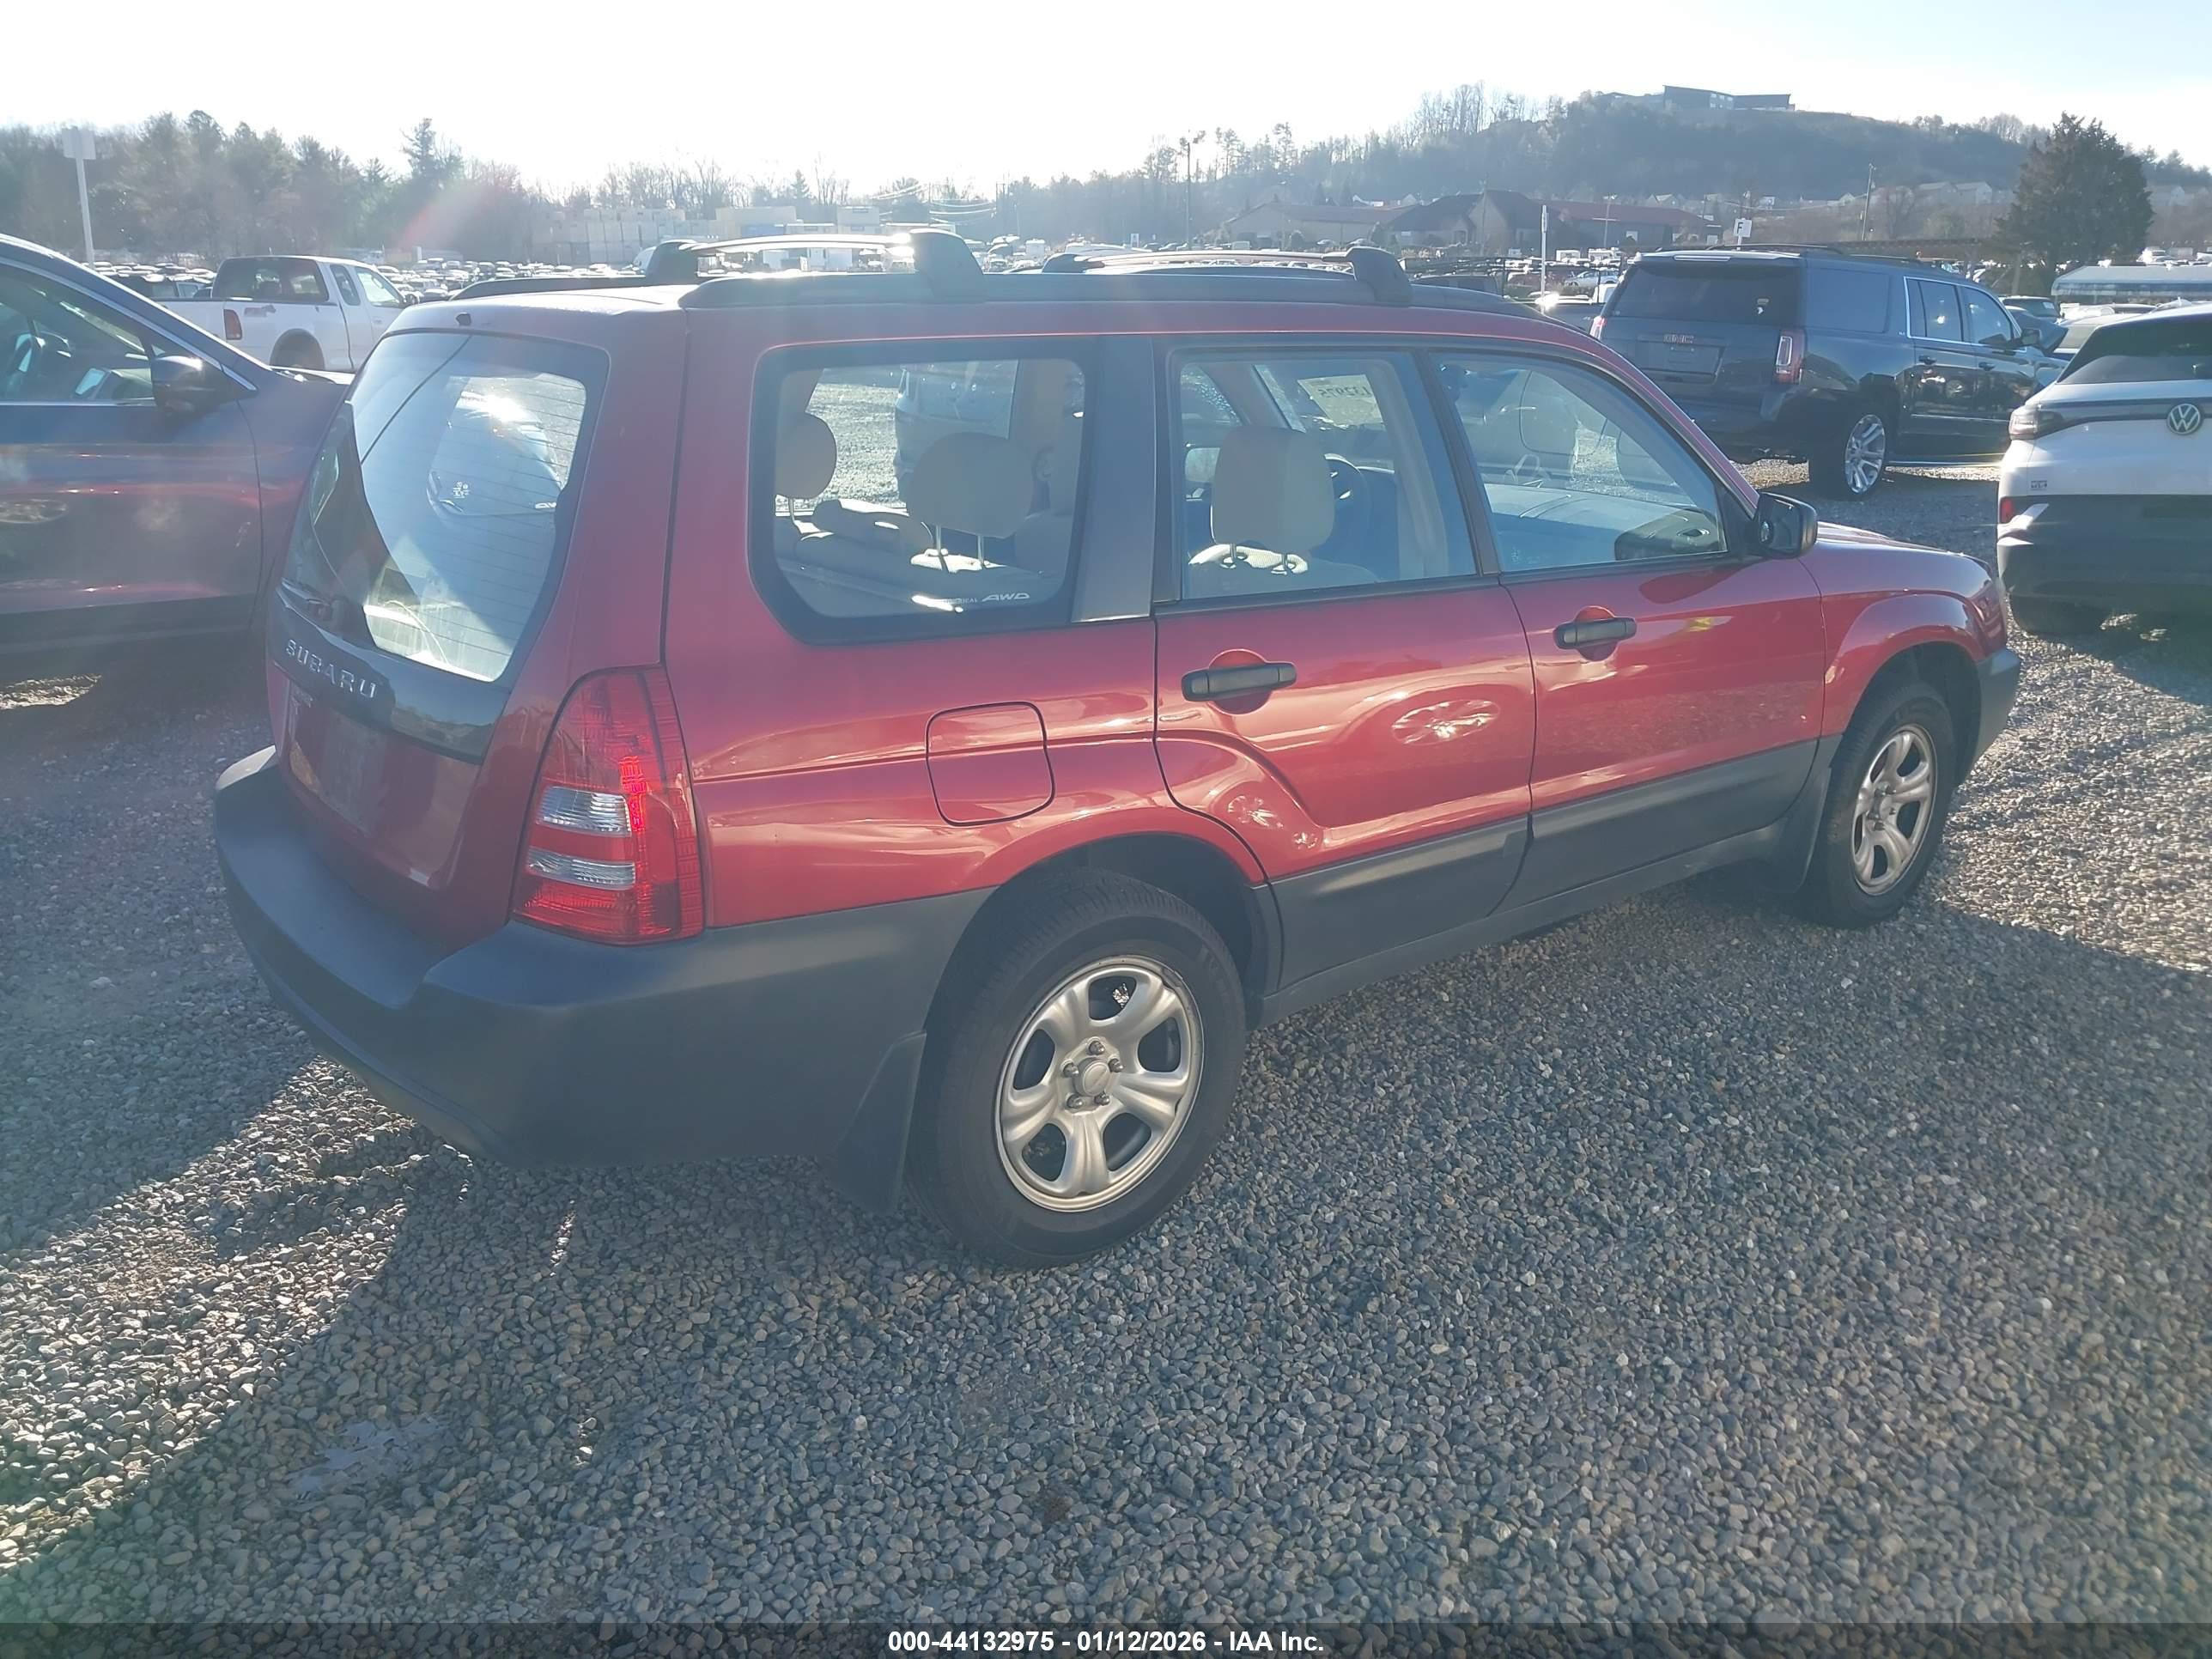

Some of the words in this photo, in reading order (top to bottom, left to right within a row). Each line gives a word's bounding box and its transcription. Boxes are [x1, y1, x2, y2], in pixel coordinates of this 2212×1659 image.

[1736, 222, 1744, 234] F
[981, 592, 1030, 603] AWD
[285, 639, 377, 699] SUBARU
